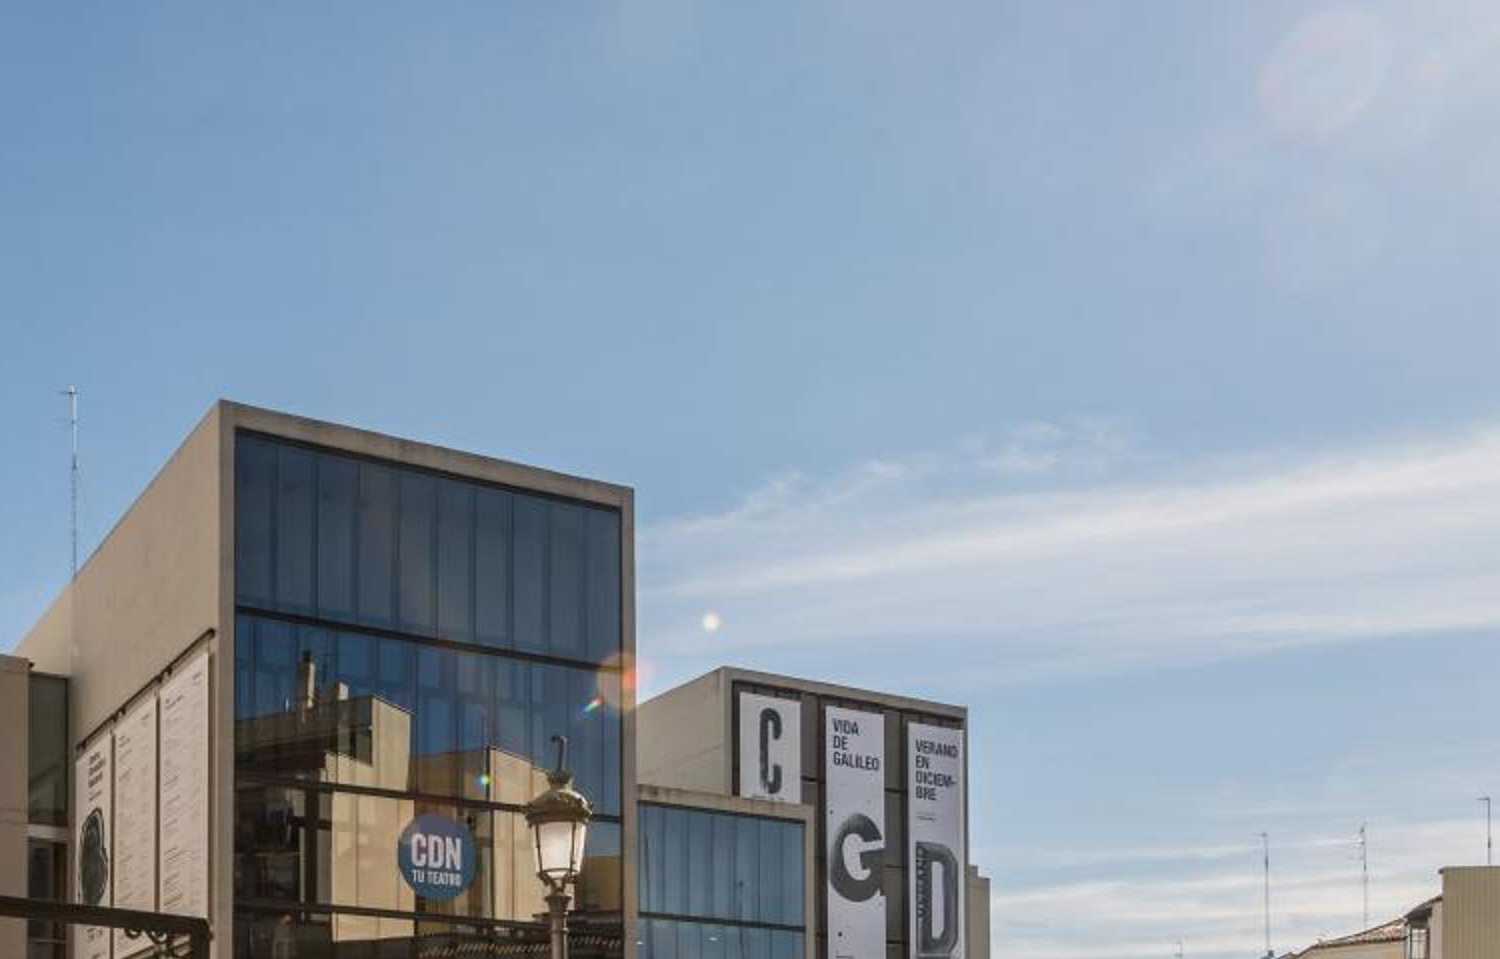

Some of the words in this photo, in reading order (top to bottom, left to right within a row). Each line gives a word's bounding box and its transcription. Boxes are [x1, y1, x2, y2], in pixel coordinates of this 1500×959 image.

[832, 718, 860, 736] VIDA
[832, 735, 849, 751] DE
[915, 739, 958, 759] VERANO
[832, 751, 880, 771] GALILEO
[915, 755, 930, 770] EN
[915, 771, 957, 788] DICIEM-
[915, 786, 937, 801] BRE
[411, 832, 462, 870] CDN
[412, 869, 425, 883] TU
[427, 871, 462, 887] TEATRO
